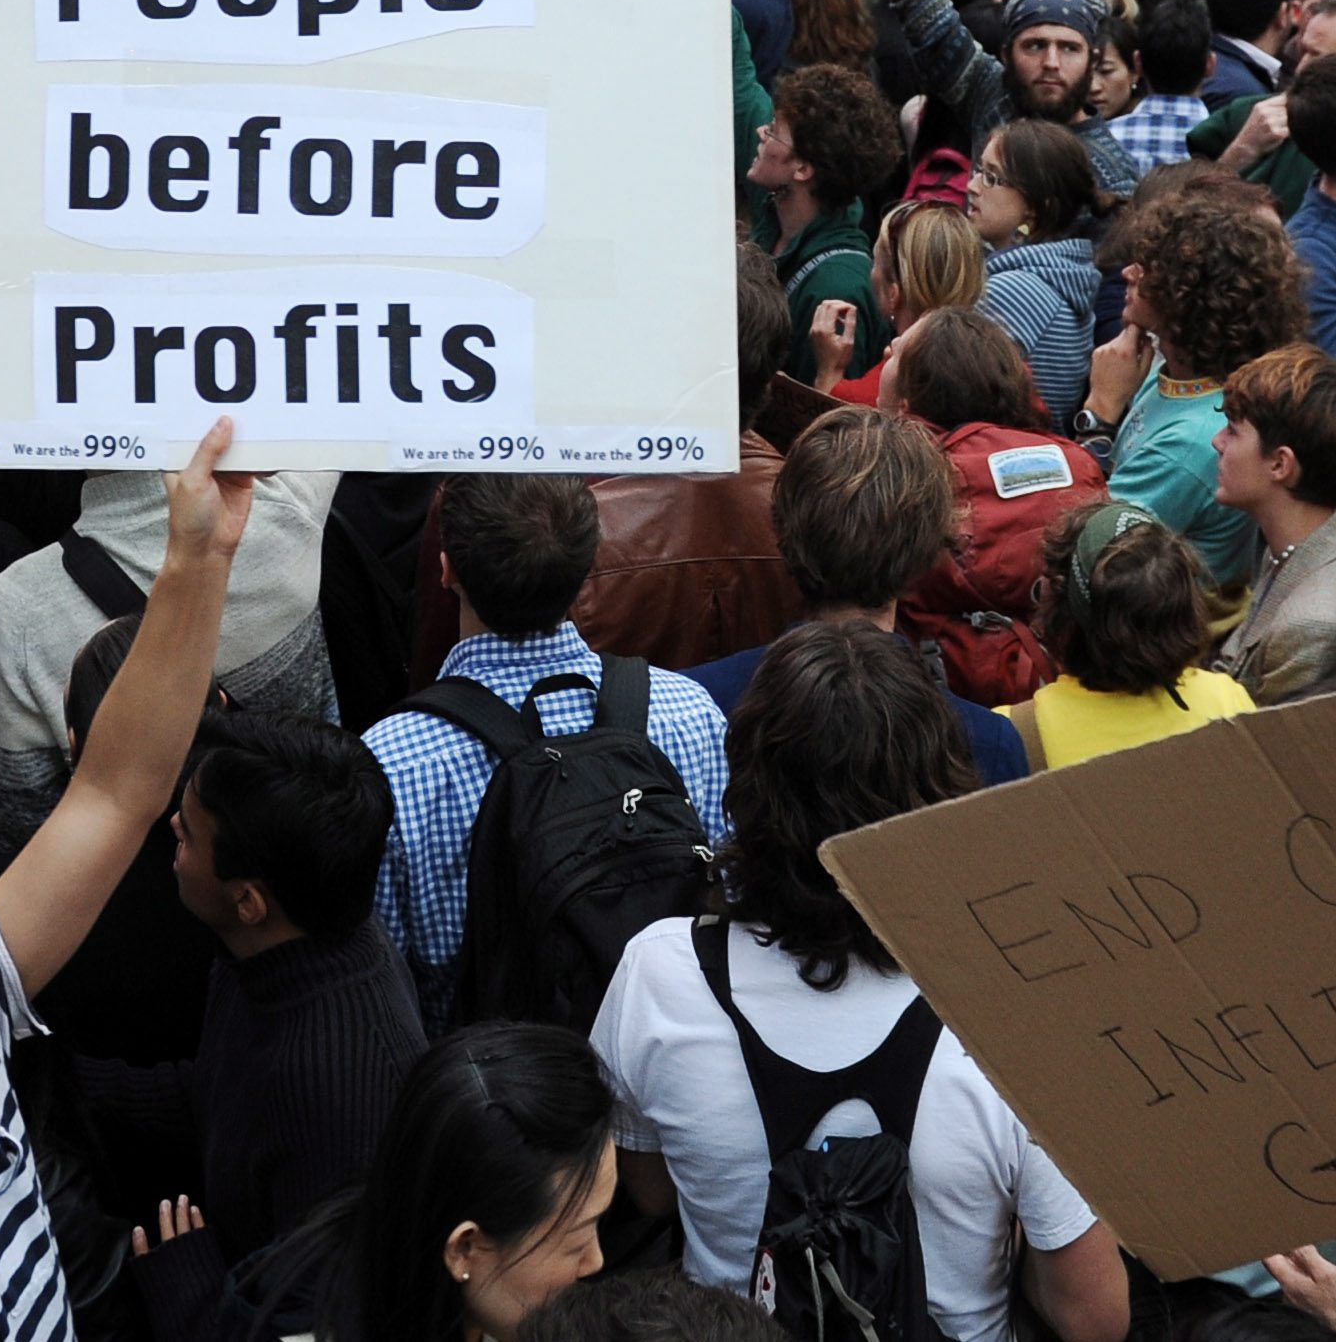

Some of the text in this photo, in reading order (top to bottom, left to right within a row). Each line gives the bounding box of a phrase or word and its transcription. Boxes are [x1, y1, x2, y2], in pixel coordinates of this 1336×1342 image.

[68, 112, 500, 220] before
[54, 303, 497, 404] Profits
[14, 434, 146, 460] We are the 99%
[404, 436, 545, 461] We are the 99%
[559, 436, 704, 462] We are the 99%
[964, 872, 1202, 985] END
